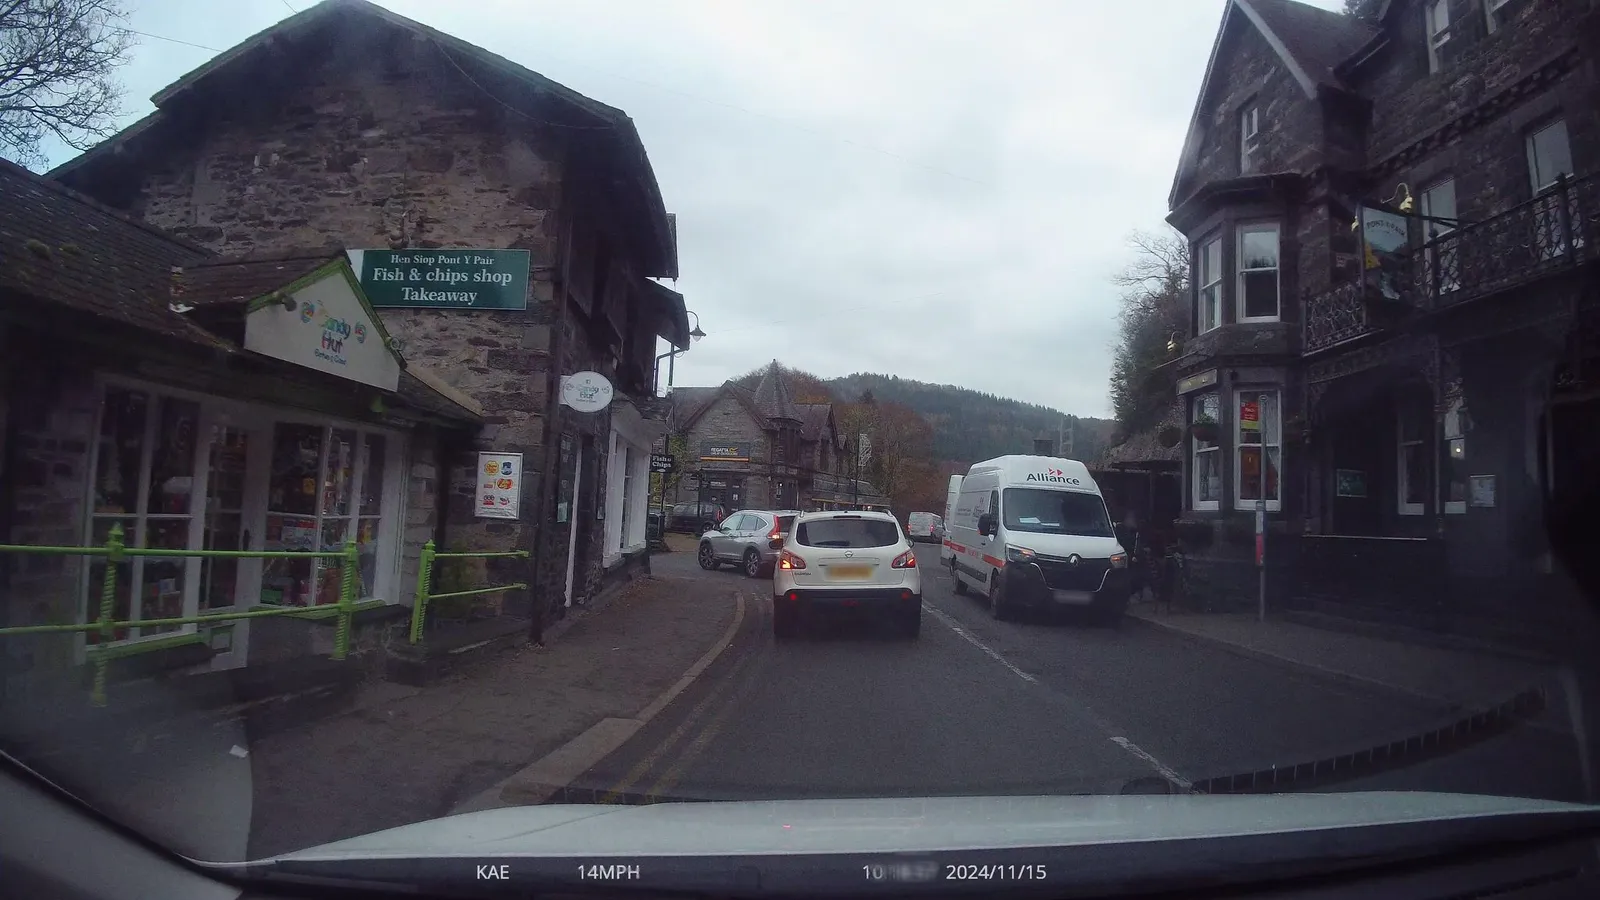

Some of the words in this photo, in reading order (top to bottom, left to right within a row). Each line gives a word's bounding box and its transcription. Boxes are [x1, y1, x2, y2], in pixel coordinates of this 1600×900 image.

[391, 254, 411, 264] Hen
[413, 254, 435, 266] Siop
[438, 255, 460, 264] Pont
[464, 255, 471, 264] Y
[473, 255, 495, 265] Pair
[372, 267, 404, 281] Fish
[409, 268, 421, 281] &
[426, 267, 469, 285] chips
[473, 268, 512, 286] shop
[401, 287, 478, 305] Takeaway
[321, 330, 343, 353] Hut
[1026, 473, 1080, 485] Alliance
